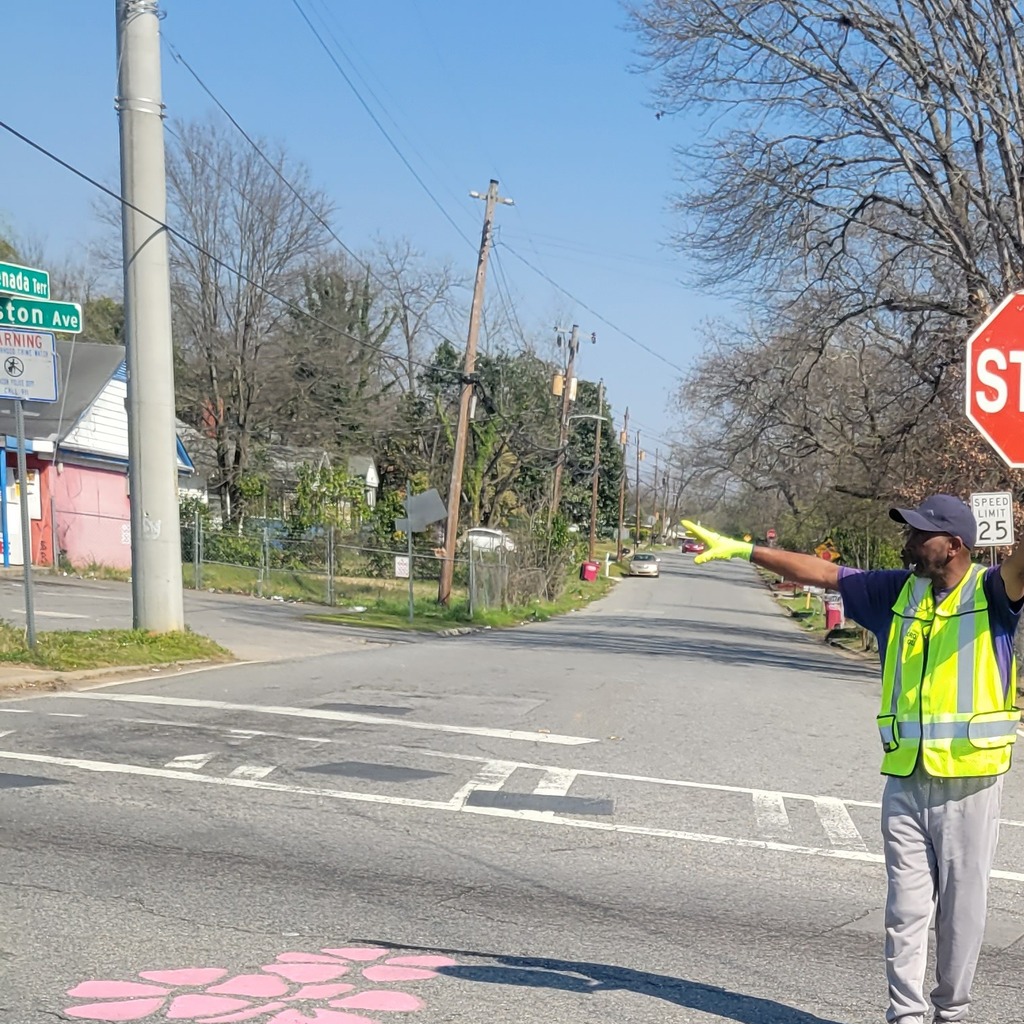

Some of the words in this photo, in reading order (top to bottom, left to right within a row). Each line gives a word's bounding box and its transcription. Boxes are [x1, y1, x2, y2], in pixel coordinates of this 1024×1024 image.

[0, 271, 30, 292] nada
[32, 277, 47, 295] Terr
[52, 310, 78, 328] Ave
[974, 497, 1009, 507] SPEED
[978, 509, 1006, 518] LIMIT
[978, 520, 1008, 541] 25
